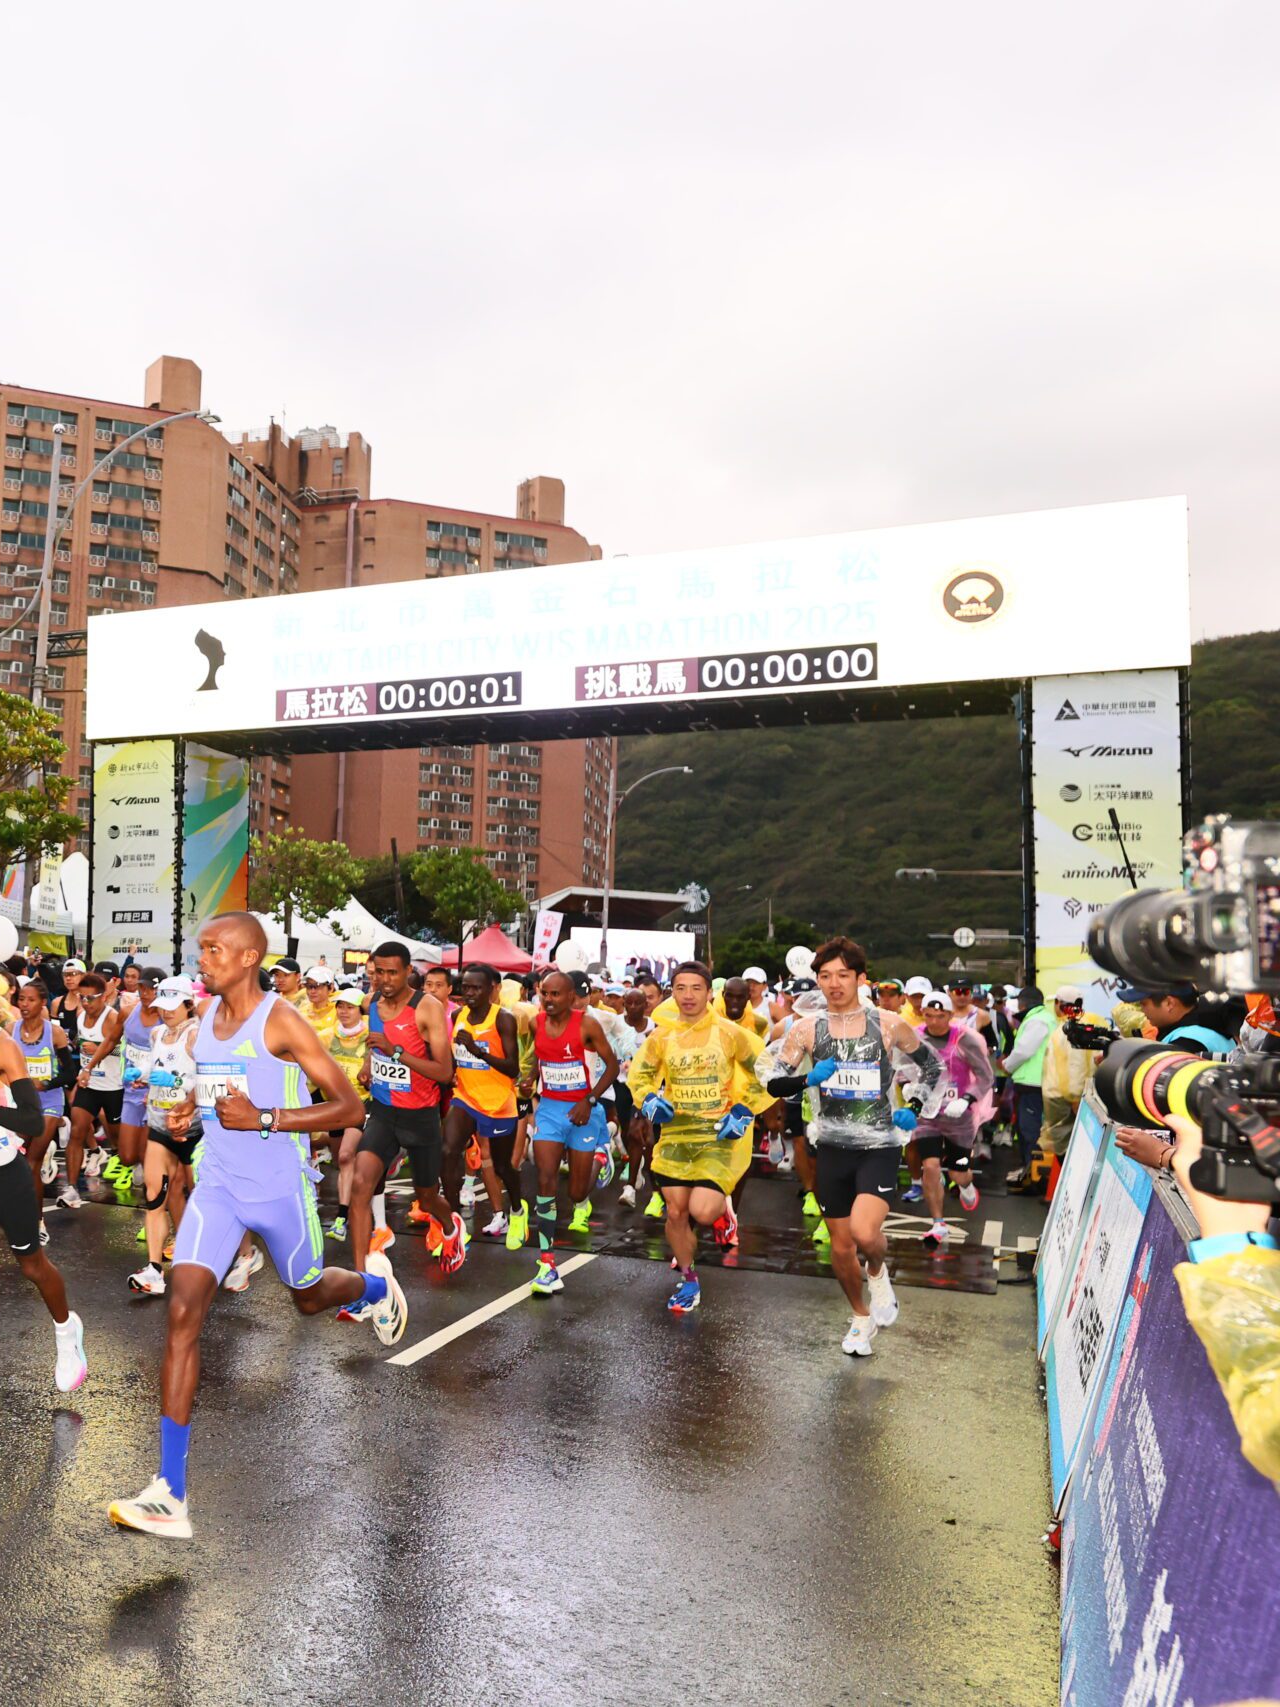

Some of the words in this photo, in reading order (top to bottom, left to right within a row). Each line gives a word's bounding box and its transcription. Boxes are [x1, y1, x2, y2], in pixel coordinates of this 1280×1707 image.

[584, 661, 687, 699] 挑戰馬
[701, 648, 874, 688] 00:00:00
[283, 686, 368, 719] 馬拉松
[379, 676, 517, 711] 00:00:01
[545, 1070, 580, 1082] SHUMAY
[838, 1074, 860, 1086] LIN
[674, 1087, 717, 1099] CHANG
